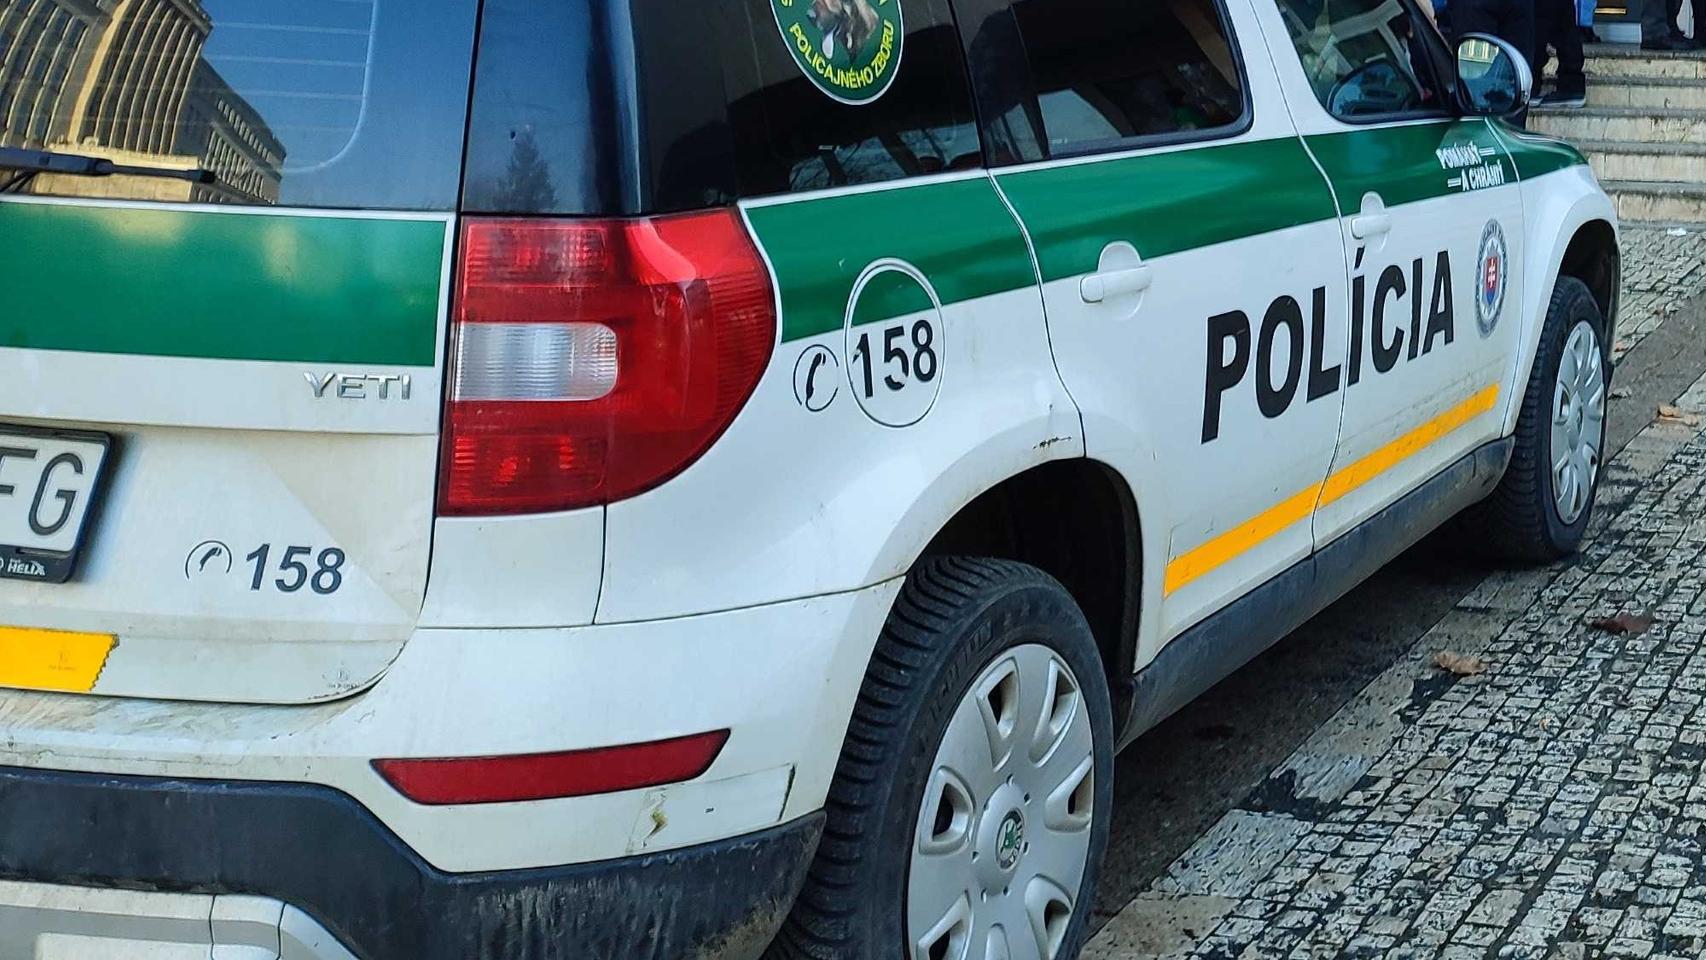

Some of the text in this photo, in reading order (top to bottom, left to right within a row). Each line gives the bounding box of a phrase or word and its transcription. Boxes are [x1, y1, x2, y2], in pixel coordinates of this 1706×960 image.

[789, 20, 894, 89] POLICAJNÉHO ZBORU
[1461, 168, 1470, 191] A
[852, 319, 937, 399] 158
[1201, 246, 1454, 444] POLÍCIA
[303, 371, 412, 401] YETI
[245, 543, 346, 595] 158
